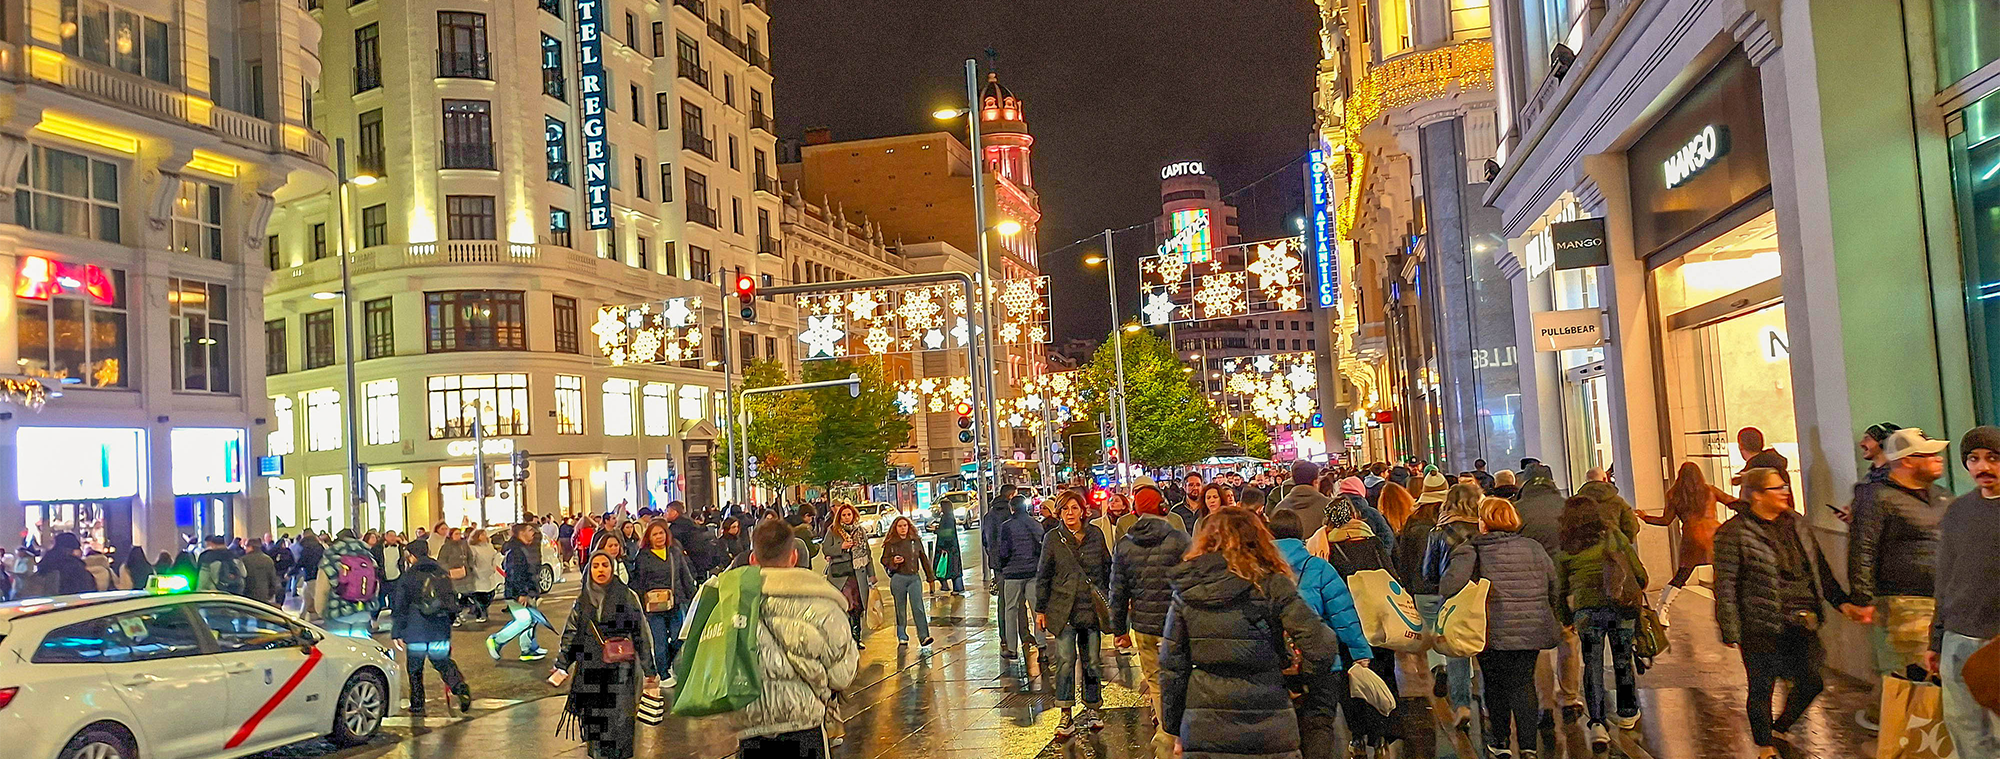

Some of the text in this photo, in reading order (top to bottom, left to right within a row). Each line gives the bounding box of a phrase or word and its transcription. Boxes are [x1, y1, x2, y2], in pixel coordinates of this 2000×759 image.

[582, 75, 608, 226] REGENTE
[1161, 161, 1206, 179] CAPITOL
[1664, 125, 1716, 189] MANGO
[1311, 152, 1333, 305] HOTEL ATLANTICO
[1556, 237, 1603, 251] MANGO
[1541, 324, 1596, 337] PULL&BEAR
